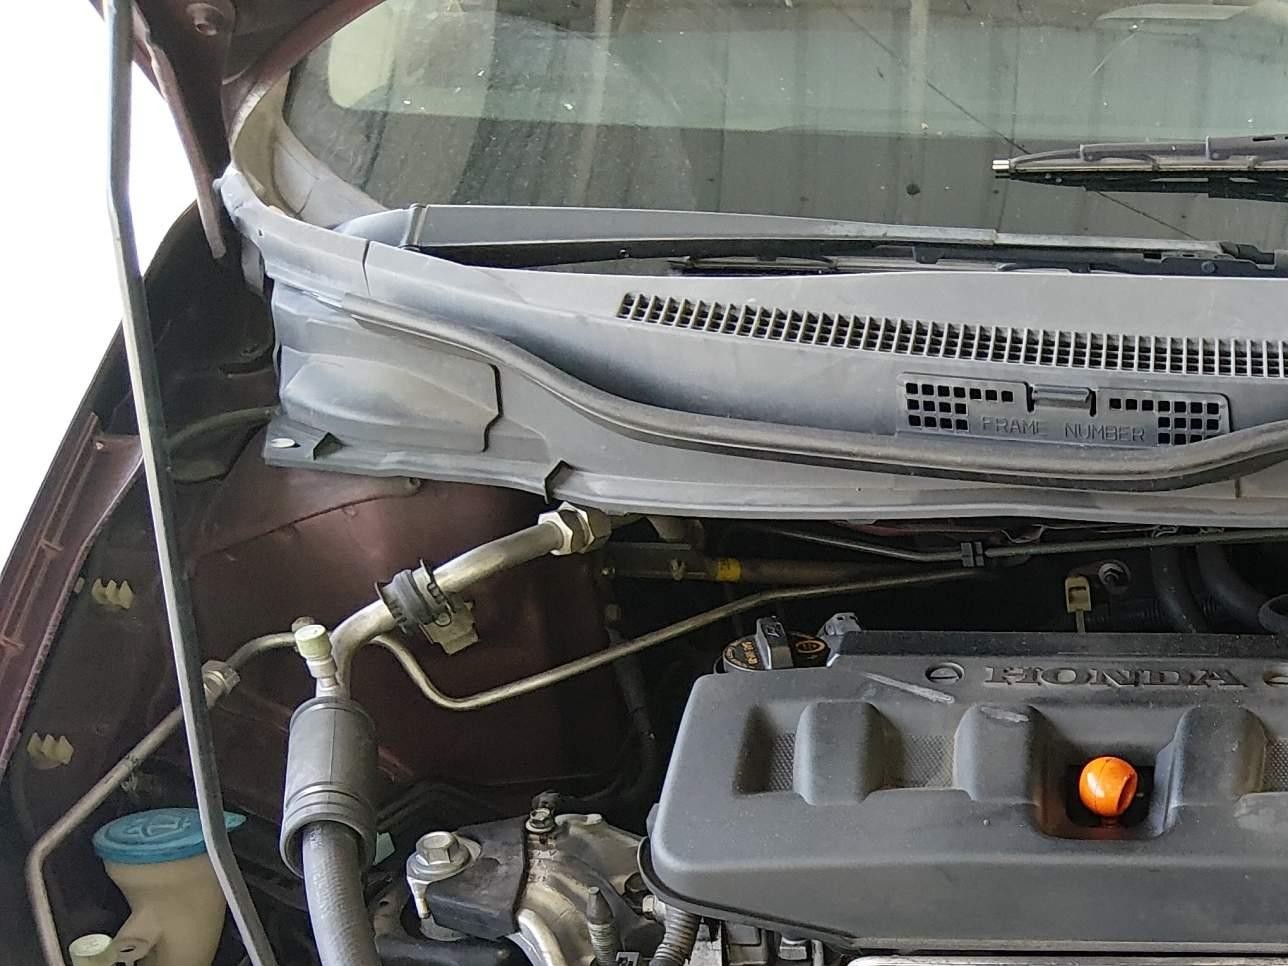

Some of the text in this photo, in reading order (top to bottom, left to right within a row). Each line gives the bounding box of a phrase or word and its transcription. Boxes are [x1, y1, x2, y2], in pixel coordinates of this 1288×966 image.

[982, 416, 1146, 442] FRAME NUMBER
[984, 666, 1249, 688] HONDA
